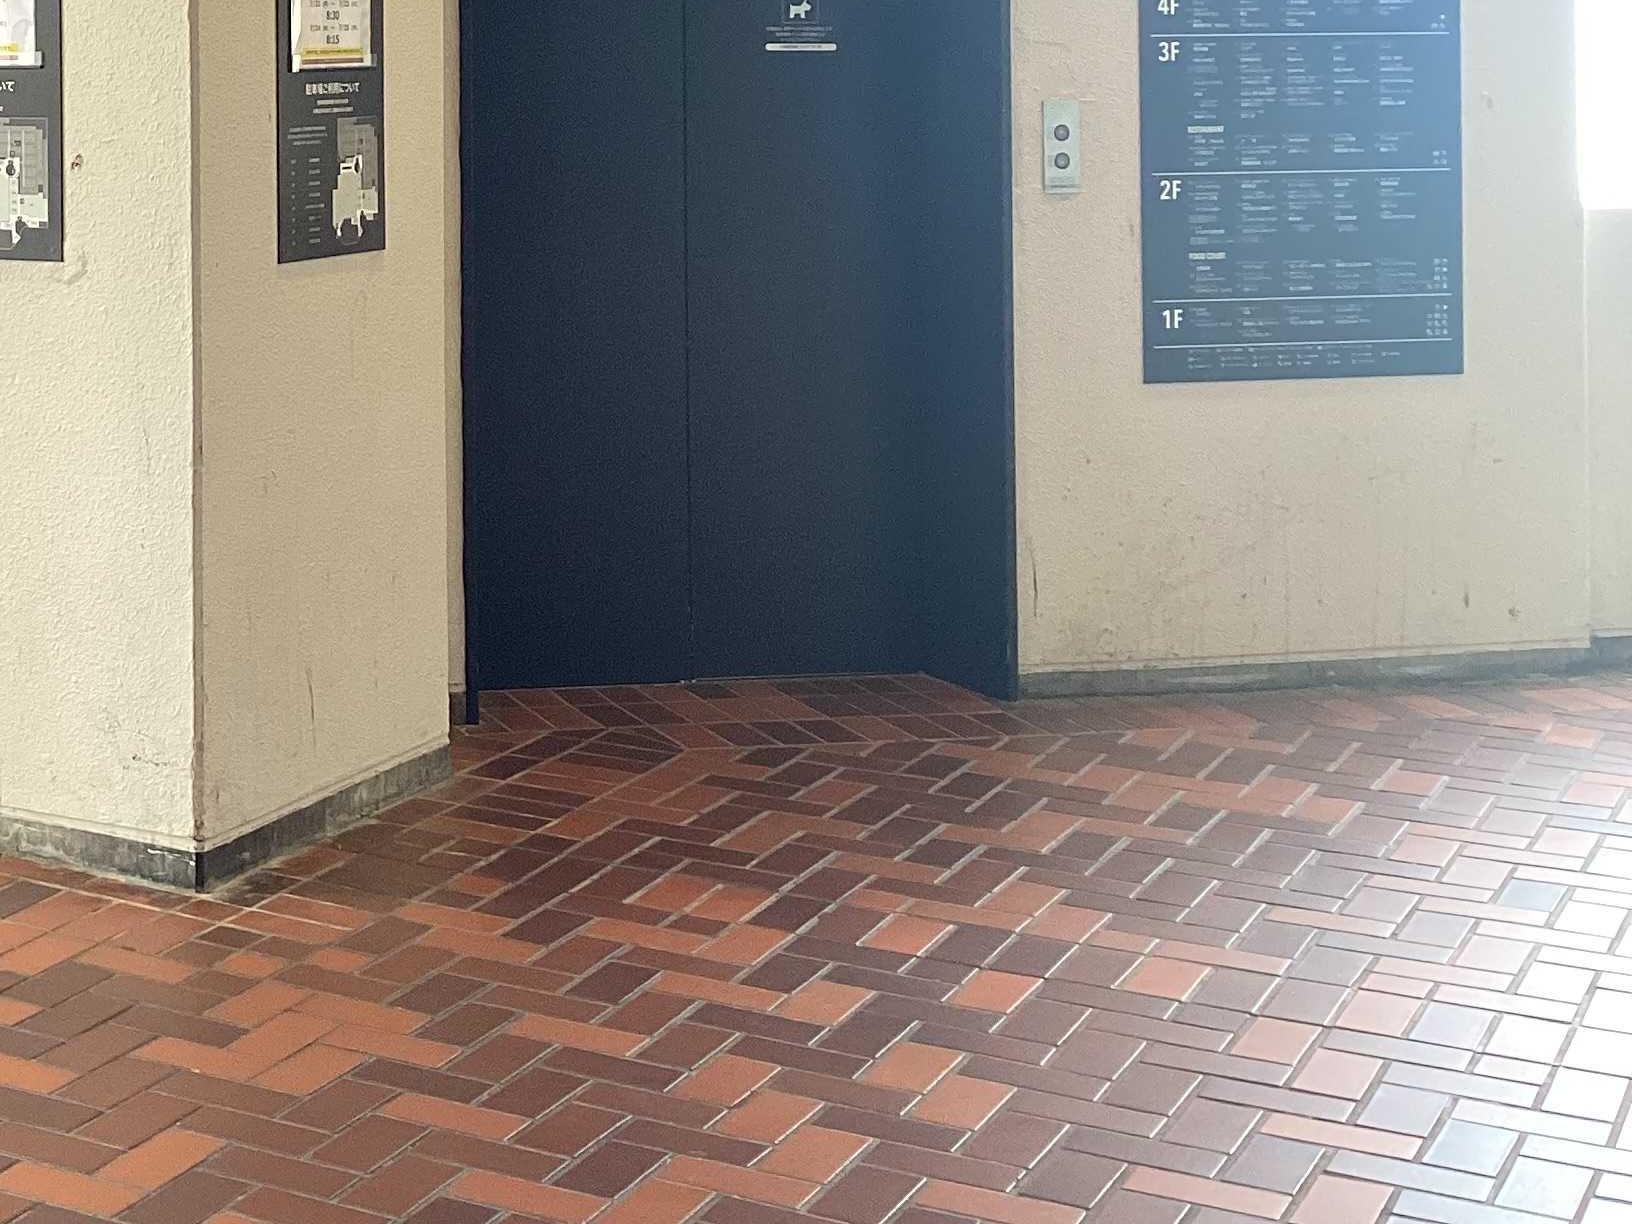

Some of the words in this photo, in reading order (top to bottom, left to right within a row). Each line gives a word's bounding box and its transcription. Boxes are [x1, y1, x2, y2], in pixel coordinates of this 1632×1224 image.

[326, 34, 340, 45] 8:15
[1158, 41, 1180, 62] 3F
[1159, 180, 1182, 200] 2F
[1162, 309, 1184, 329] 1F
